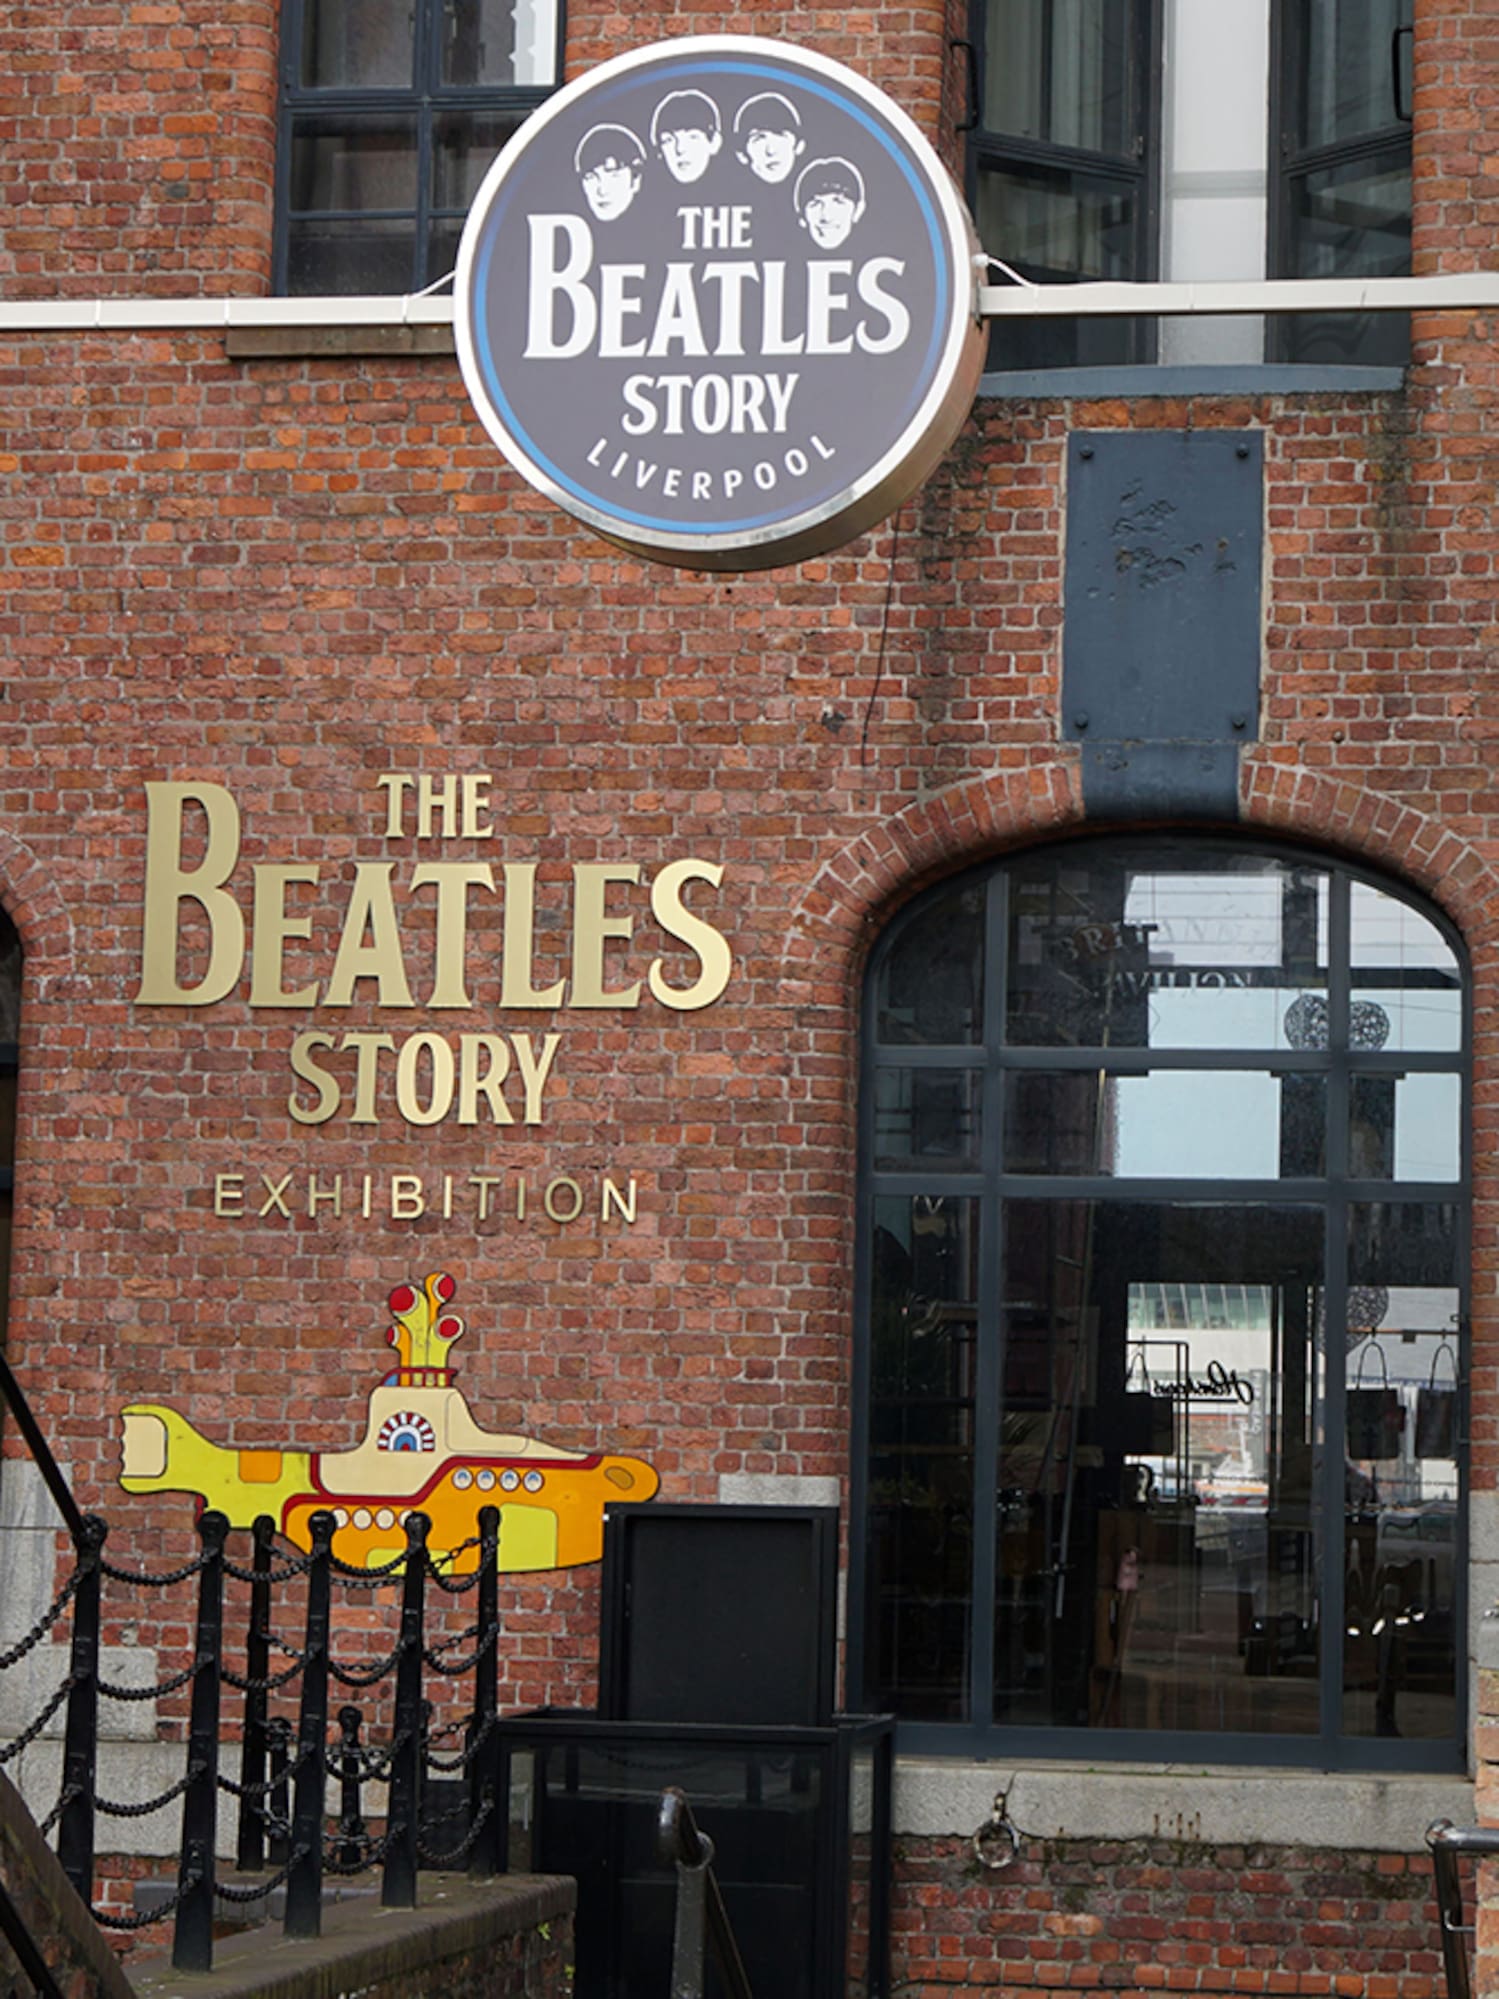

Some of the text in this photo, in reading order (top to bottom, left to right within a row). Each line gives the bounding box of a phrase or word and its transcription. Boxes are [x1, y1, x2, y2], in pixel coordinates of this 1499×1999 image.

[677, 205, 753, 249] THE
[523, 213, 911, 358] BEATLES
[621, 373, 800, 435] STORY
[586, 434, 836, 499] LIVERPOOL
[376, 774, 494, 838] THE
[133, 780, 733, 1011] BEATLES
[287, 1031, 563, 1126] STORY
[213, 1172, 639, 1224] EXHIBITION
